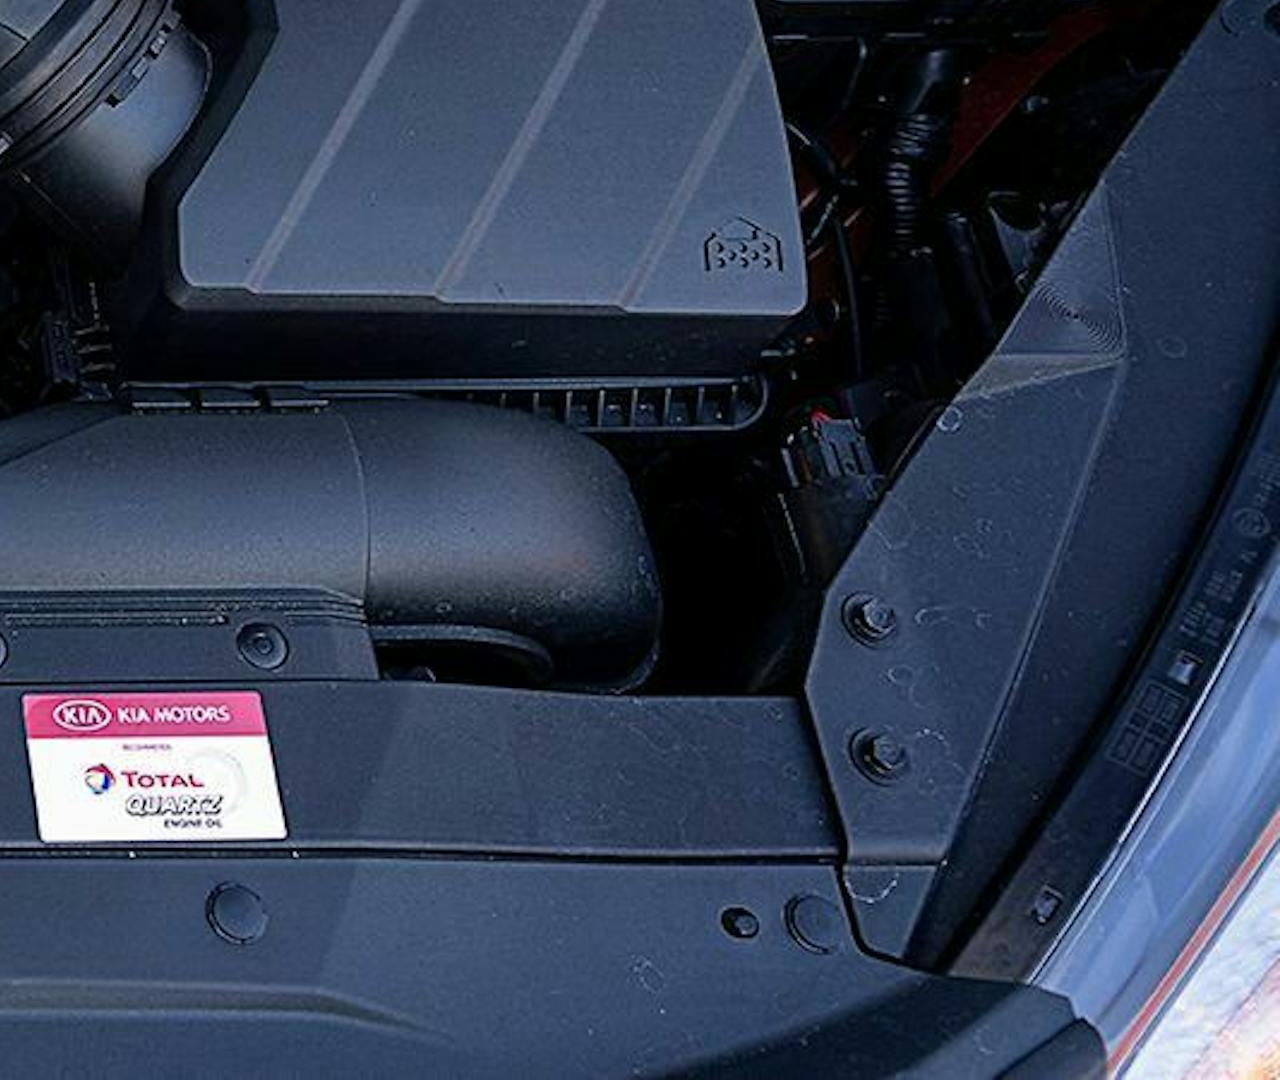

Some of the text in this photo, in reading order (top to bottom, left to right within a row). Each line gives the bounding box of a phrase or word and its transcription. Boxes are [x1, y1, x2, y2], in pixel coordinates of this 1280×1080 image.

[64, 705, 230, 723] KIA KIA MOTORS
[121, 771, 205, 788] TOTAL
[126, 794, 223, 816] QUARTZ
